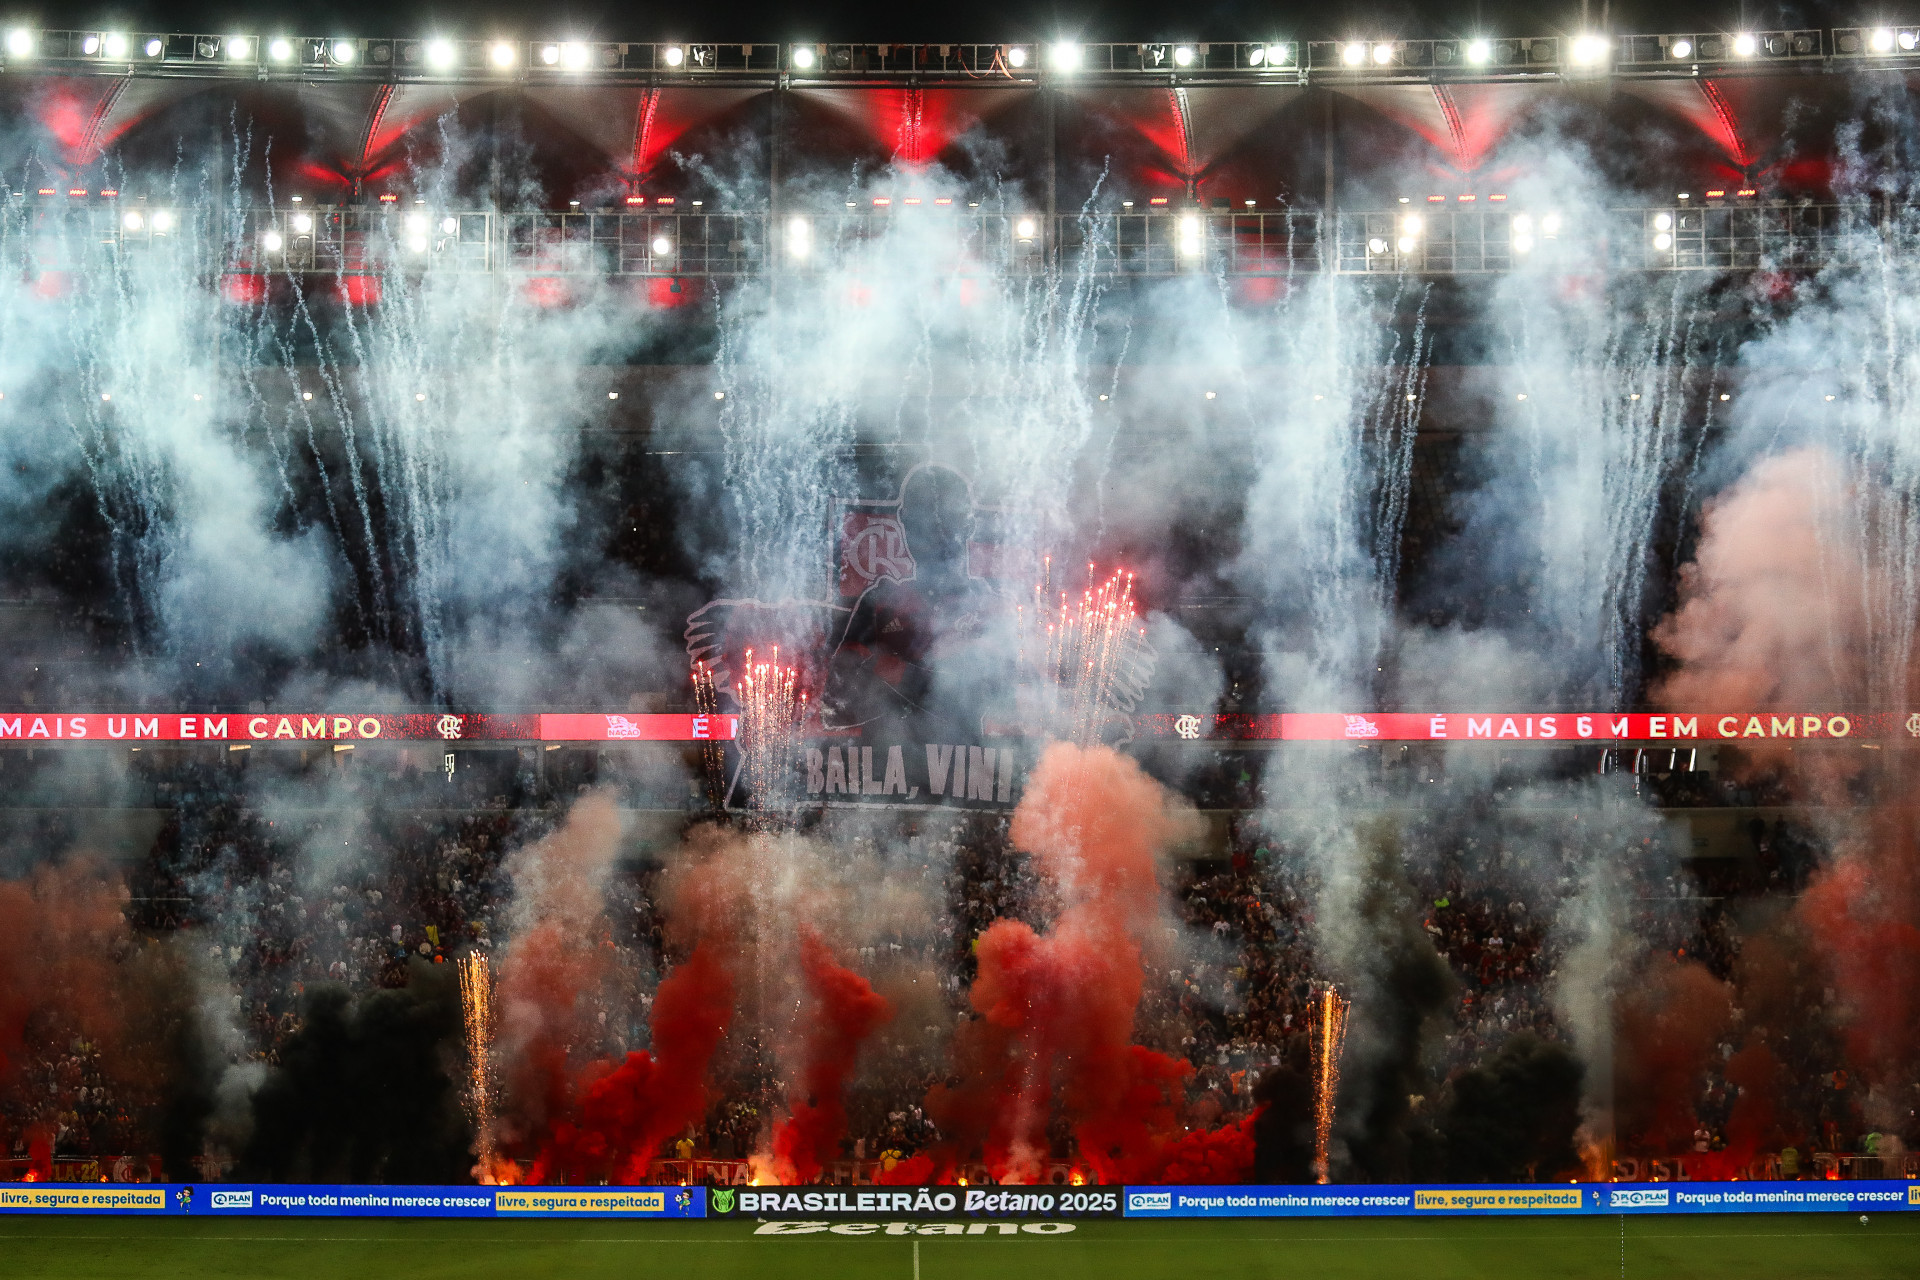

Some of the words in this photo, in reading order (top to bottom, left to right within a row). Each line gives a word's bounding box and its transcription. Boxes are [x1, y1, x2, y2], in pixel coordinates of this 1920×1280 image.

[0, 717, 87, 738] MAIS
[107, 717, 159, 738] UM
[180, 717, 228, 738] EM
[248, 717, 381, 739] CAMPO
[1430, 713, 1447, 738] É
[1466, 716, 1557, 738] MAIS
[1649, 716, 1698, 738] EM
[1718, 716, 1851, 738] CAMPO
[806, 745, 919, 799] BAILA,
[926, 743, 1014, 803] VINI
[1, 1191, 32, 1205] livre,
[35, 1194, 79, 1207] segura
[82, 1195, 90, 1204] e
[92, 1192, 161, 1207] respeitada
[228, 1194, 251, 1202] PLAN
[260, 1194, 306, 1209] Porque
[308, 1194, 338, 1206] toda
[340, 1193, 390, 1206] menina
[392, 1197, 441, 1207] merece
[443, 1197, 492, 1207] crescer
[498, 1195, 530, 1209] livre,
[532, 1198, 577, 1211] segura
[580, 1198, 588, 1208] e
[590, 1196, 660, 1211] respeitada
[739, 1187, 957, 1212] BRASILEIRÃO
[963, 1190, 1054, 1211] Betano
[1059, 1193, 1117, 1212] 2025
[1146, 1196, 1169, 1204] PLAN
[1178, 1195, 1225, 1210] Porque
[1227, 1195, 1257, 1207] toda
[1259, 1194, 1309, 1207] menina
[1311, 1196, 1360, 1206] merece
[1362, 1195, 1411, 1206] crescer
[1417, 1193, 1448, 1206] livre,
[1451, 1196, 1496, 1208] segura
[1498, 1196, 1506, 1205] e
[1508, 1193, 1578, 1208] respeitada
[1676, 1192, 1722, 1206] Porque
[1724, 1191, 1753, 1203] toda
[1755, 1190, 1804, 1202] menina
[1806, 1192, 1855, 1202] merece
[1857, 1192, 1904, 1202] crescer
[753, 1217, 1077, 1236] Betano
